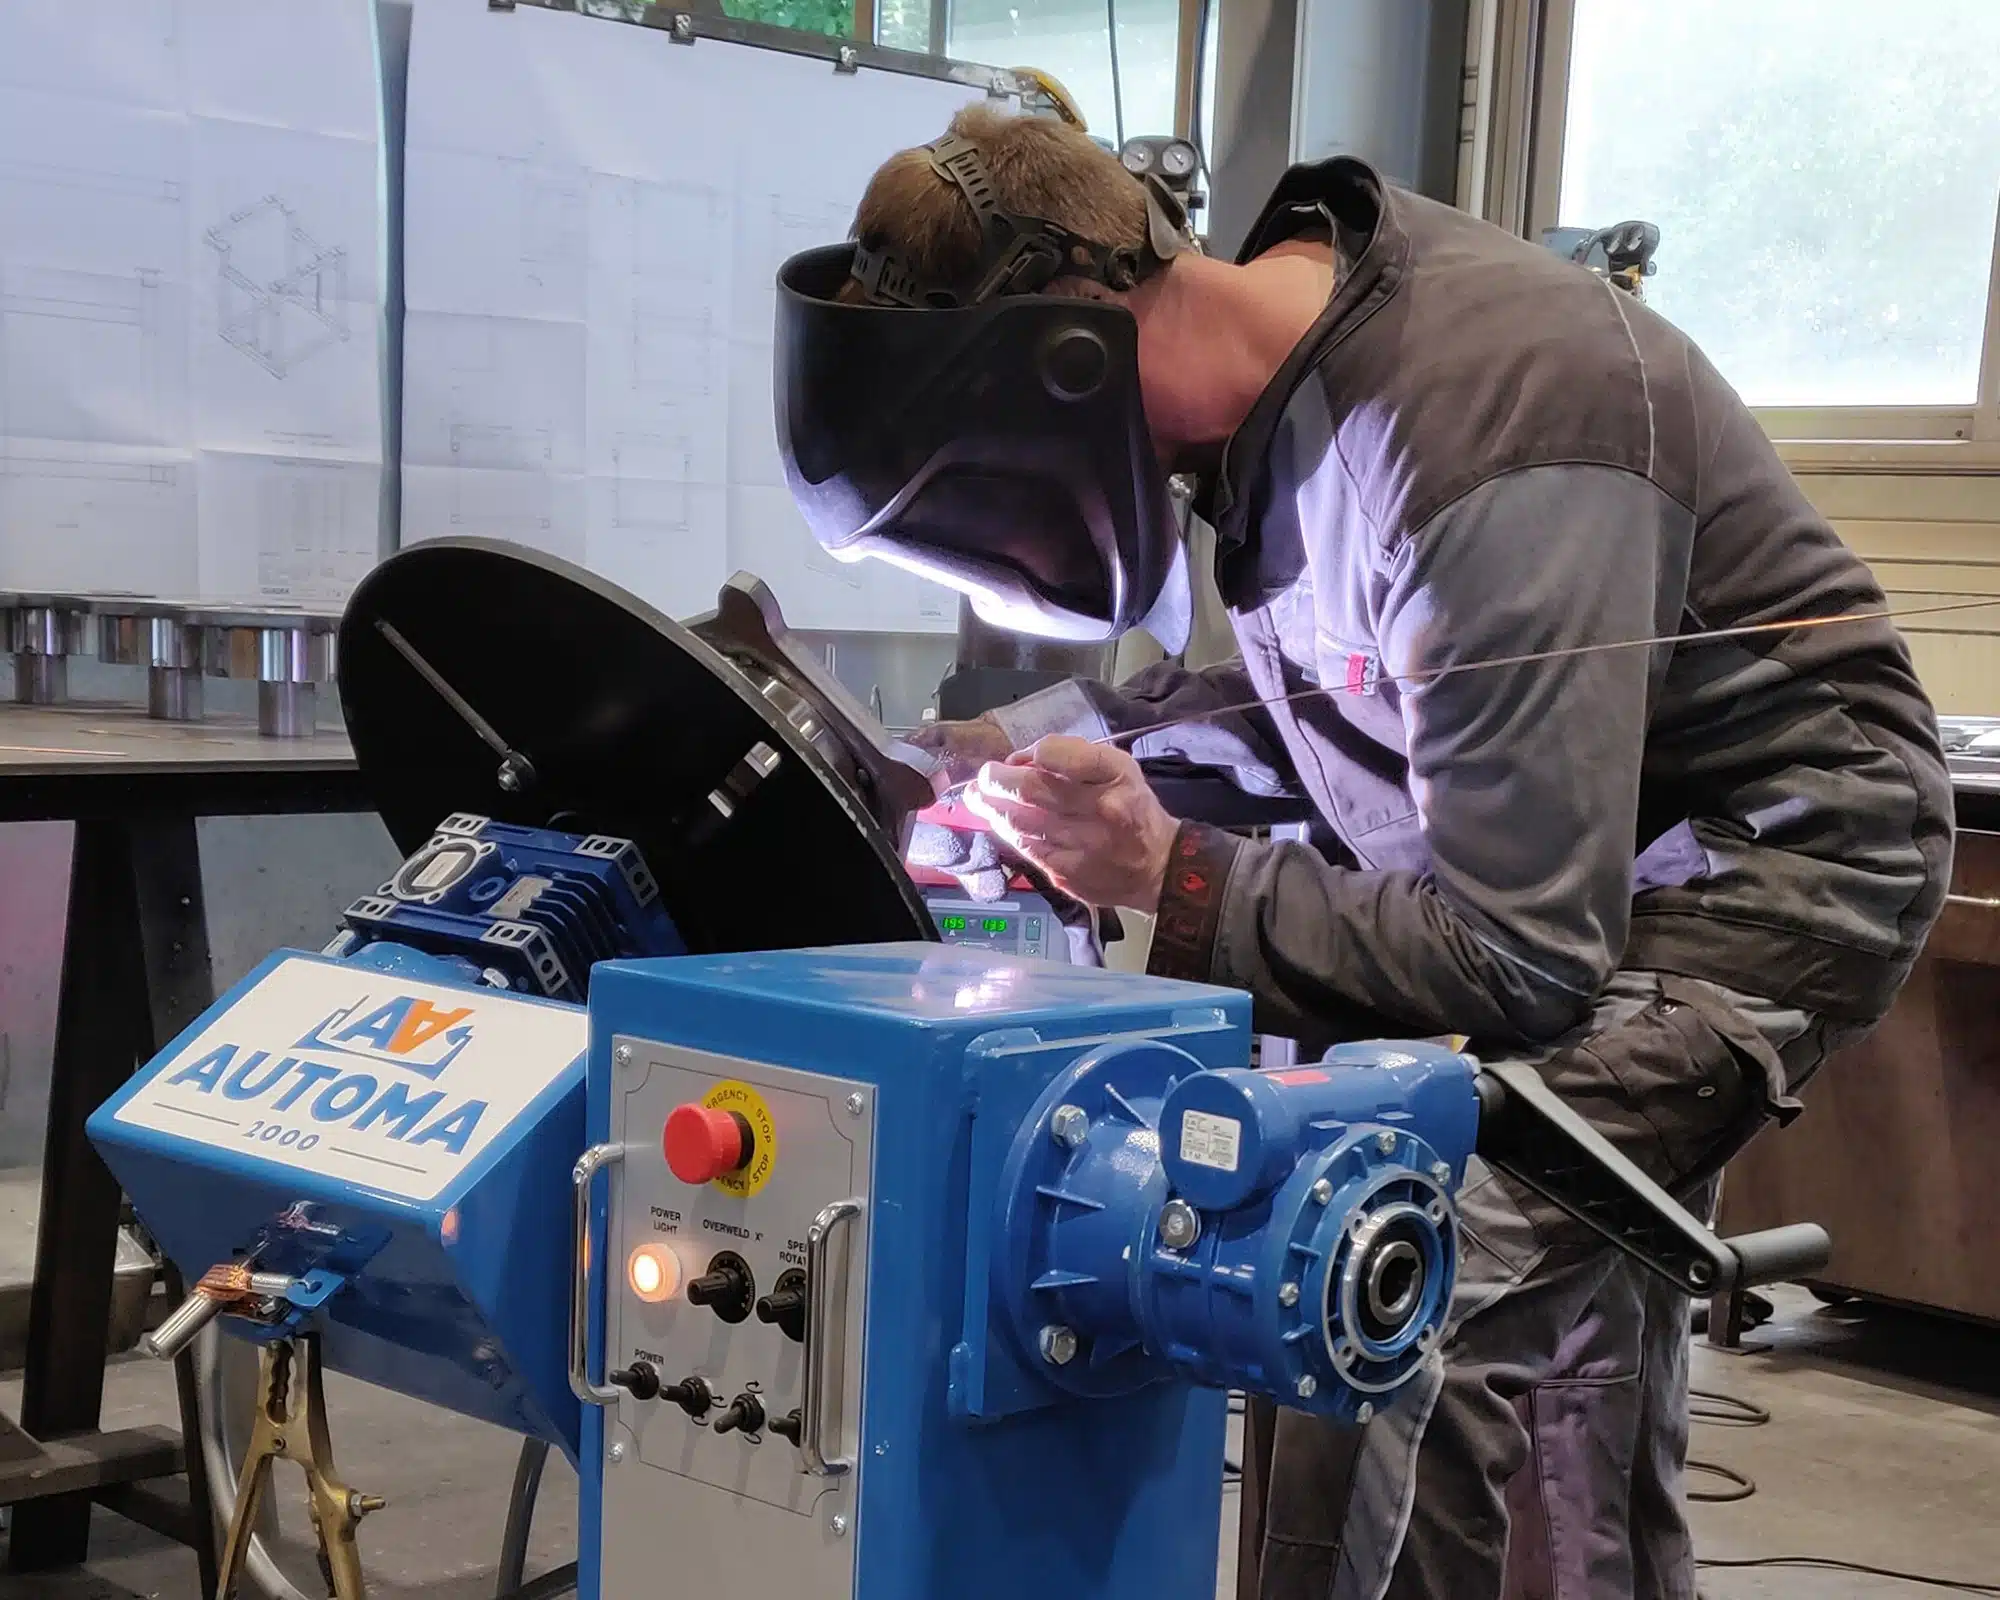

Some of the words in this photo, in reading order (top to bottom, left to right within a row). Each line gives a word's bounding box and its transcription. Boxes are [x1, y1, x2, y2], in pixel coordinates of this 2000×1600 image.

[949, 929, 956, 937] A
[164, 1043, 490, 1155] AUTOMA
[706, 1089, 749, 1109] RGENCY
[756, 1108, 772, 1143] STOP
[241, 1120, 320, 1151] 2000
[752, 1154, 770, 1183] STOP
[650, 1205, 681, 1221] POWER
[653, 1219, 678, 1234] LIGHT
[702, 1218, 750, 1239] OVERWELD
[787, 1239, 807, 1252] SPE
[634, 1348, 664, 1365] POWER
